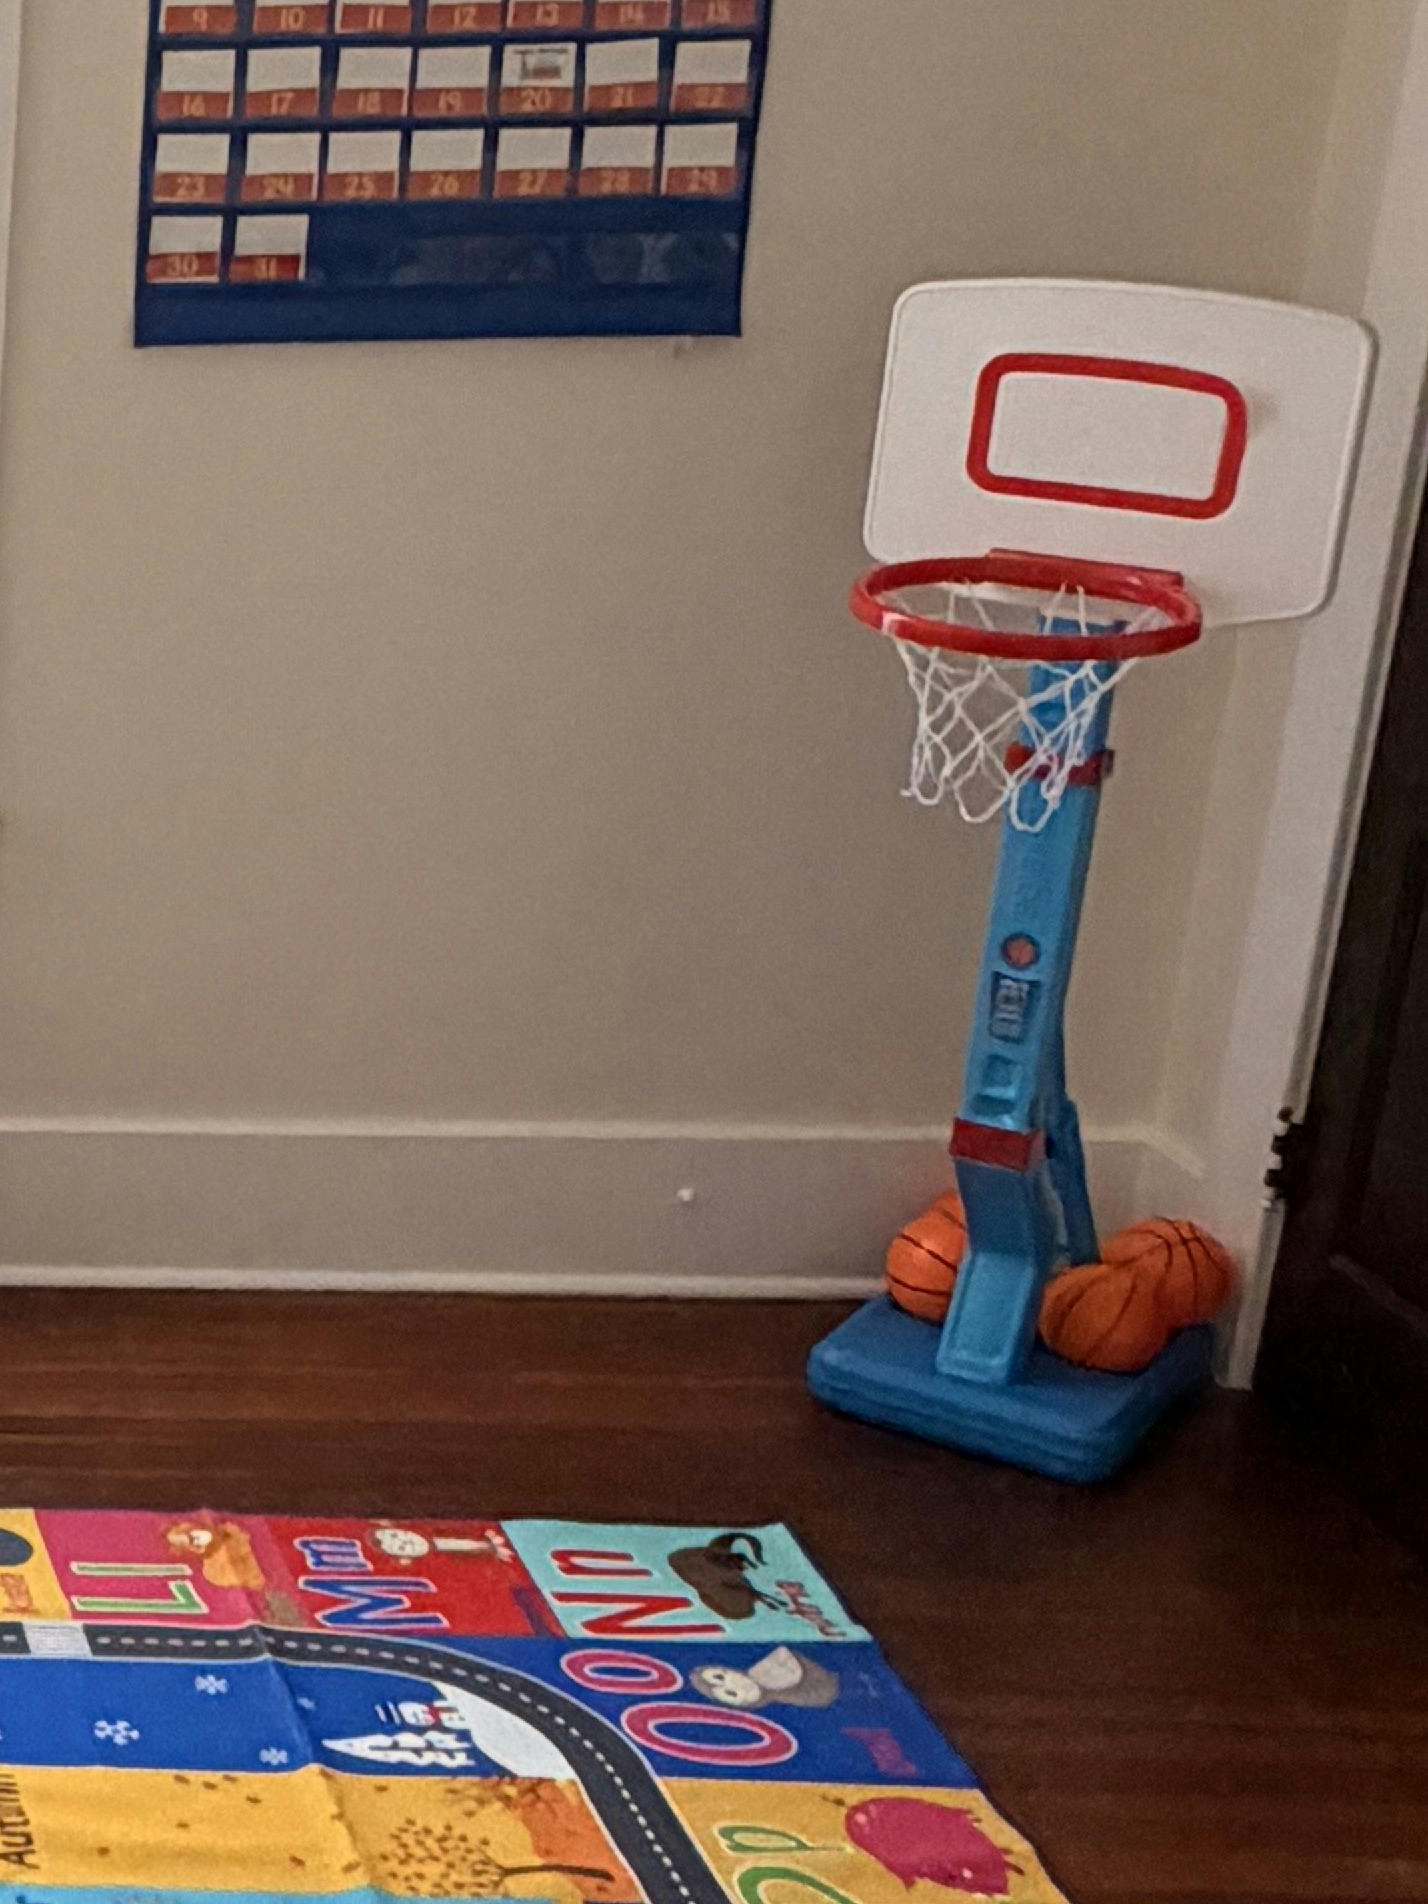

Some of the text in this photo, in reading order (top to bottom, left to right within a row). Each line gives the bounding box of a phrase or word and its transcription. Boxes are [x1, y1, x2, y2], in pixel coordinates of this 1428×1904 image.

[192, 9, 209, 30] 9
[280, 8, 306, 29] 10
[367, 7, 385, 28] 11
[454, 7, 477, 28] 12
[536, 4, 560, 26] 13
[182, 95, 206, 117] 16
[270, 91, 296, 115] 17
[438, 90, 463, 113] 19
[521, 88, 551, 110] 20
[176, 174, 206, 196] 23
[345, 175, 375, 197] 25
[431, 174, 460, 195] 26
[167, 254, 278, 278] 30 31
[292, 1536, 450, 1630] Mm
[546, 1546, 732, 1639] Nn
[559, 1647, 800, 1768] Oo
